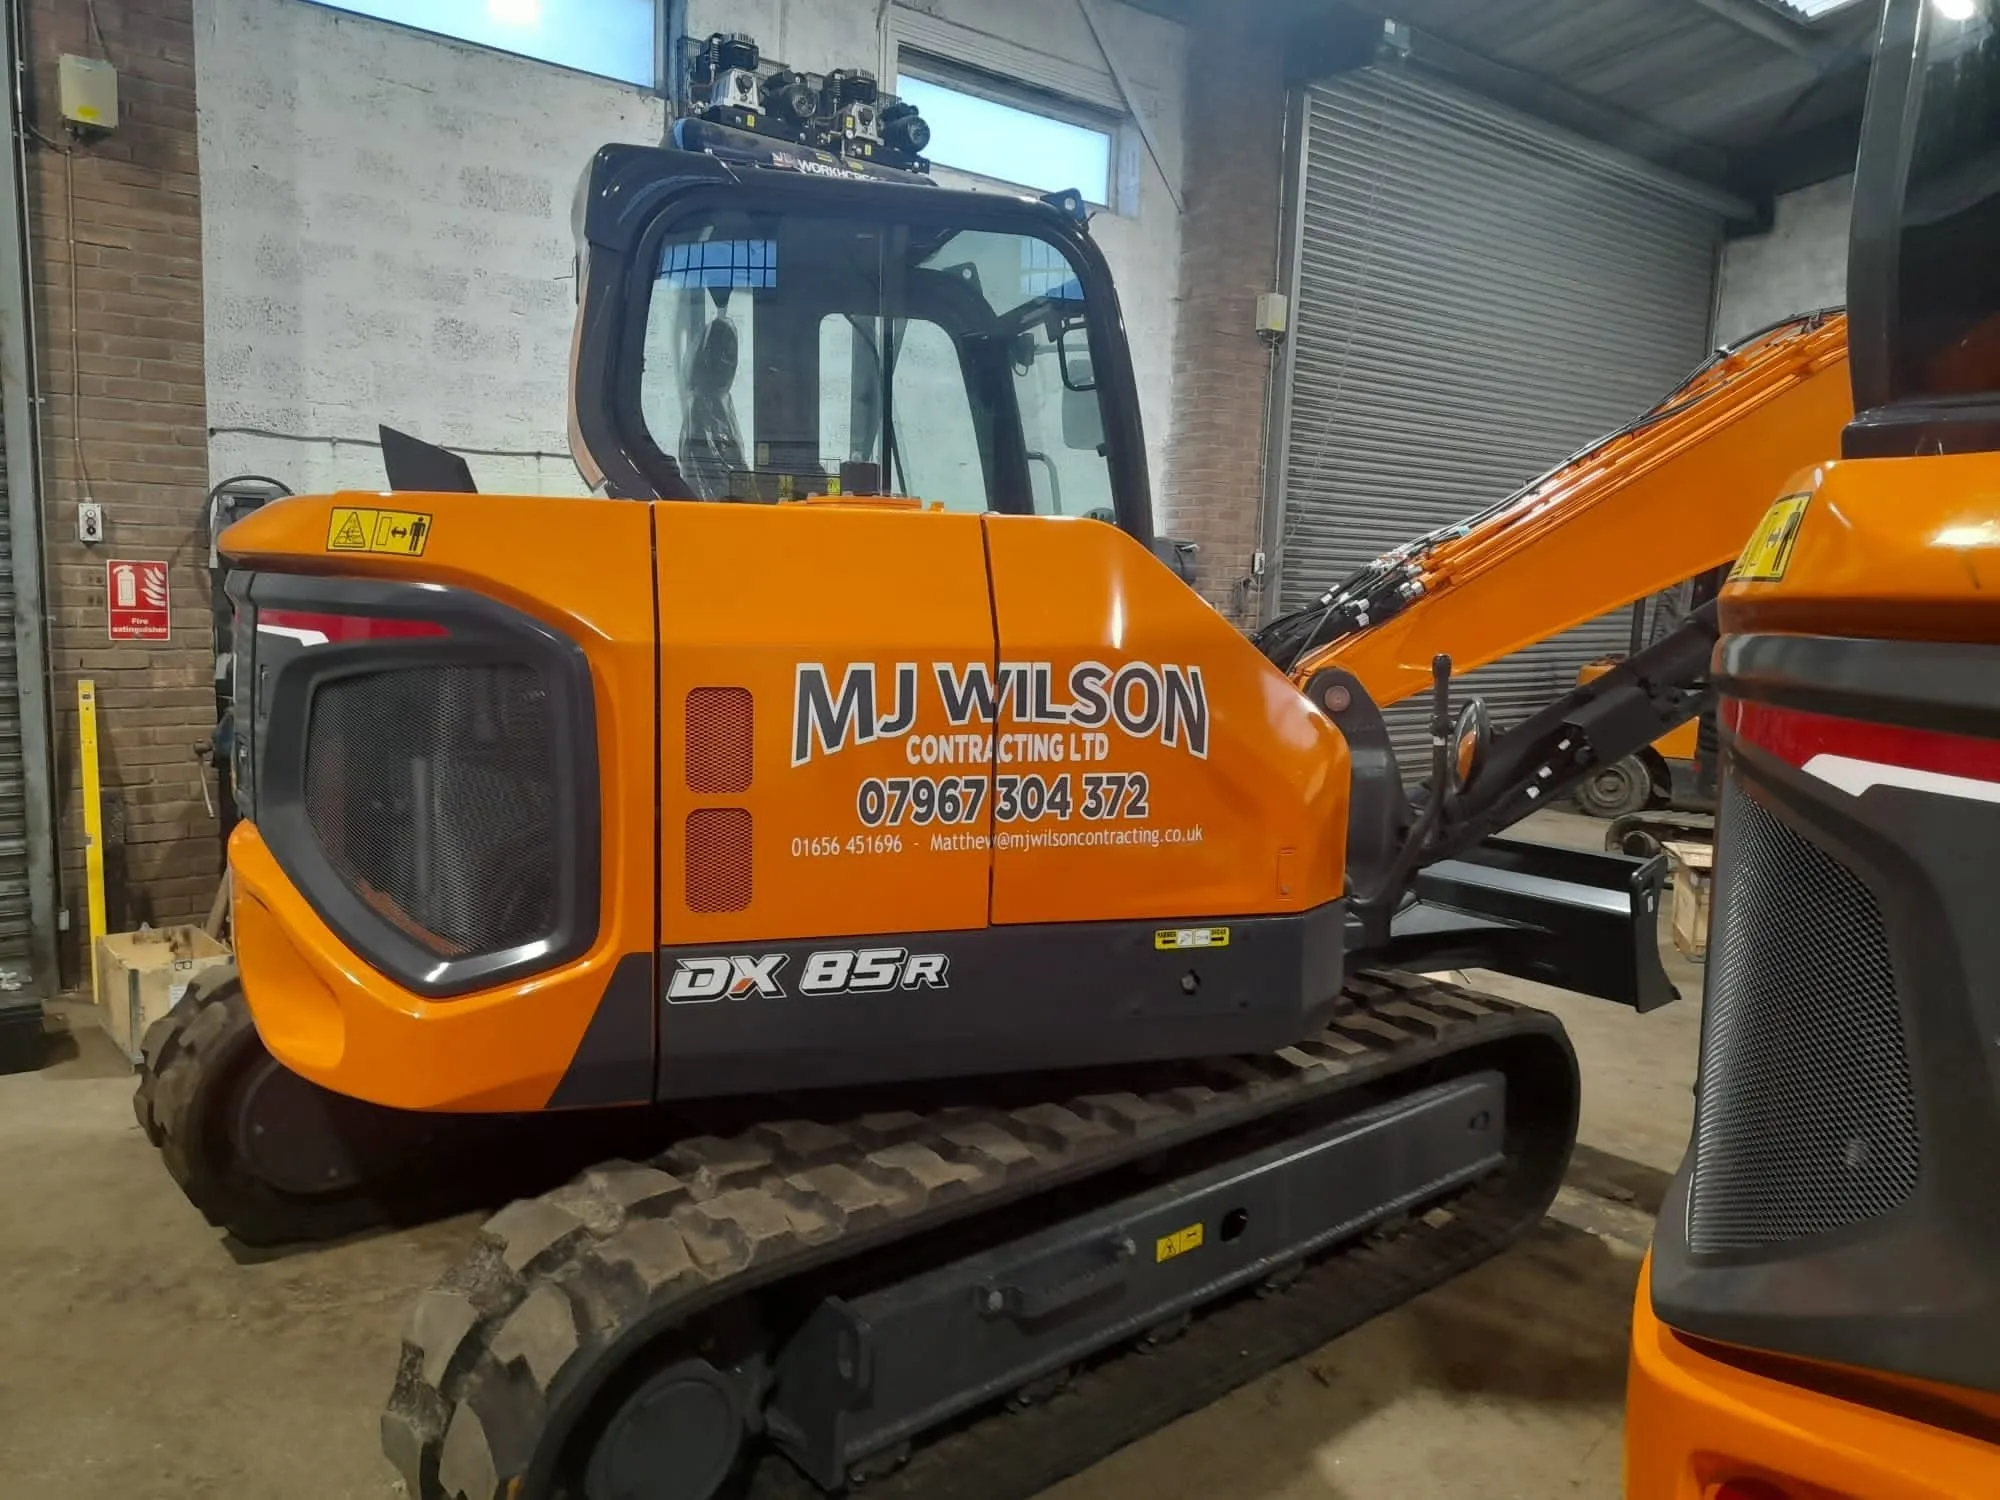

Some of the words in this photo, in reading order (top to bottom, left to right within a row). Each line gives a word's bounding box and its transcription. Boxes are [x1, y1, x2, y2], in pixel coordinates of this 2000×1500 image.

[112, 626, 167, 634] extinguisher
[131, 617, 149, 625] Fire
[791, 662, 917, 768] MJ
[932, 661, 1209, 760] WILSON
[906, 733, 1063, 764] CONTRACTING
[1069, 732, 1109, 762] LTD
[857, 776, 987, 828] 07967
[995, 774, 1072, 822] 304
[1080, 771, 1149, 819] 372
[791, 837, 840, 857] 01656
[845, 834, 903, 853] 451696
[930, 824, 1203, 853] Matthew@mjwilsoncontracting.co.uk
[666, 953, 790, 1004] DX
